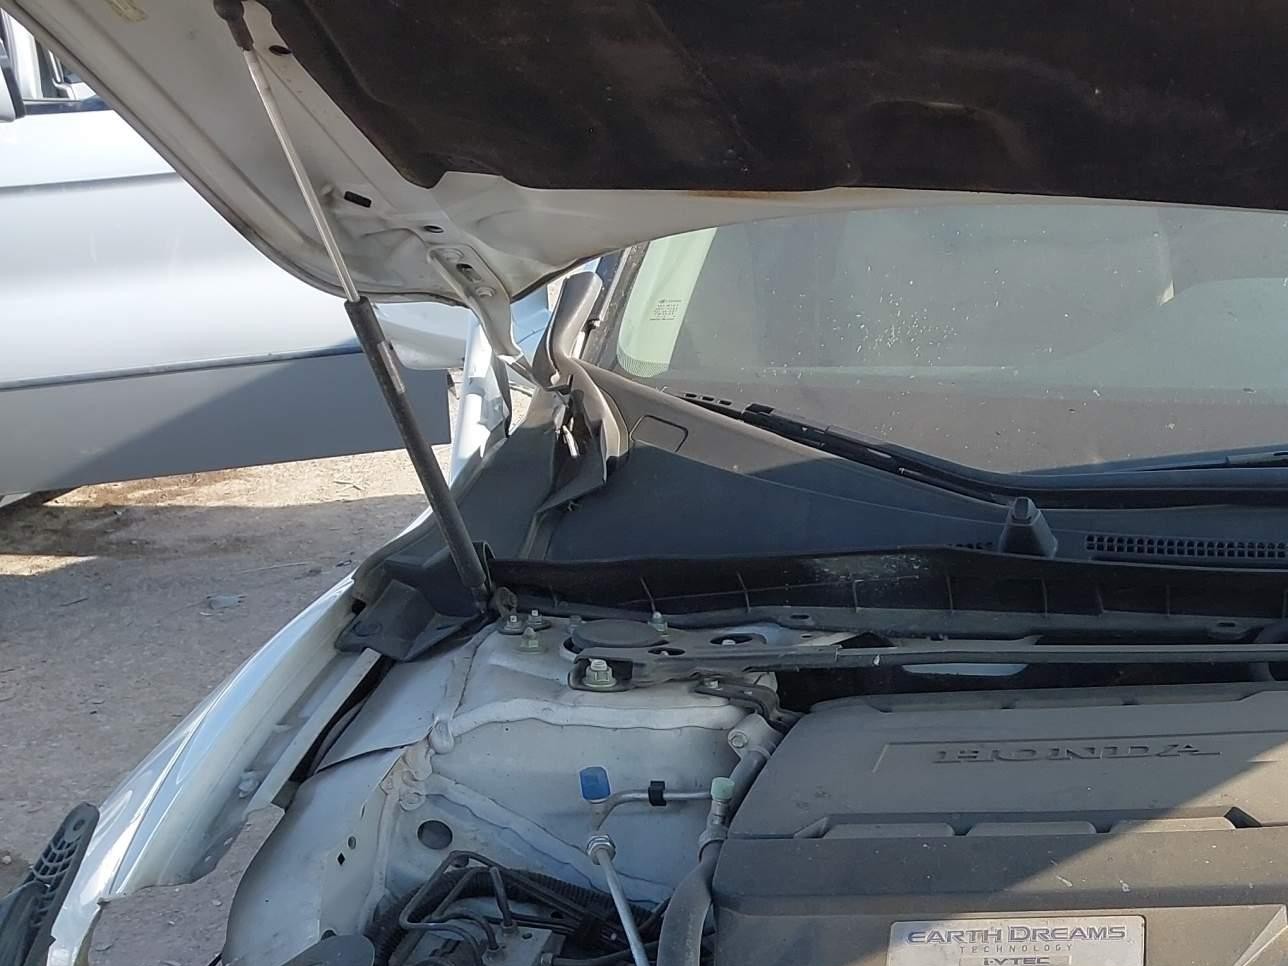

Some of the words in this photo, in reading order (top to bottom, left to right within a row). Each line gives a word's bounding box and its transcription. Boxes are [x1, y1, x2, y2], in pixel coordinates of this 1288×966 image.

[934, 744, 1222, 763] HONDA
[908, 925, 1001, 944] EARTH
[1008, 925, 1126, 941] DREAMS
[960, 944, 1073, 953] TECHNOLOGY
